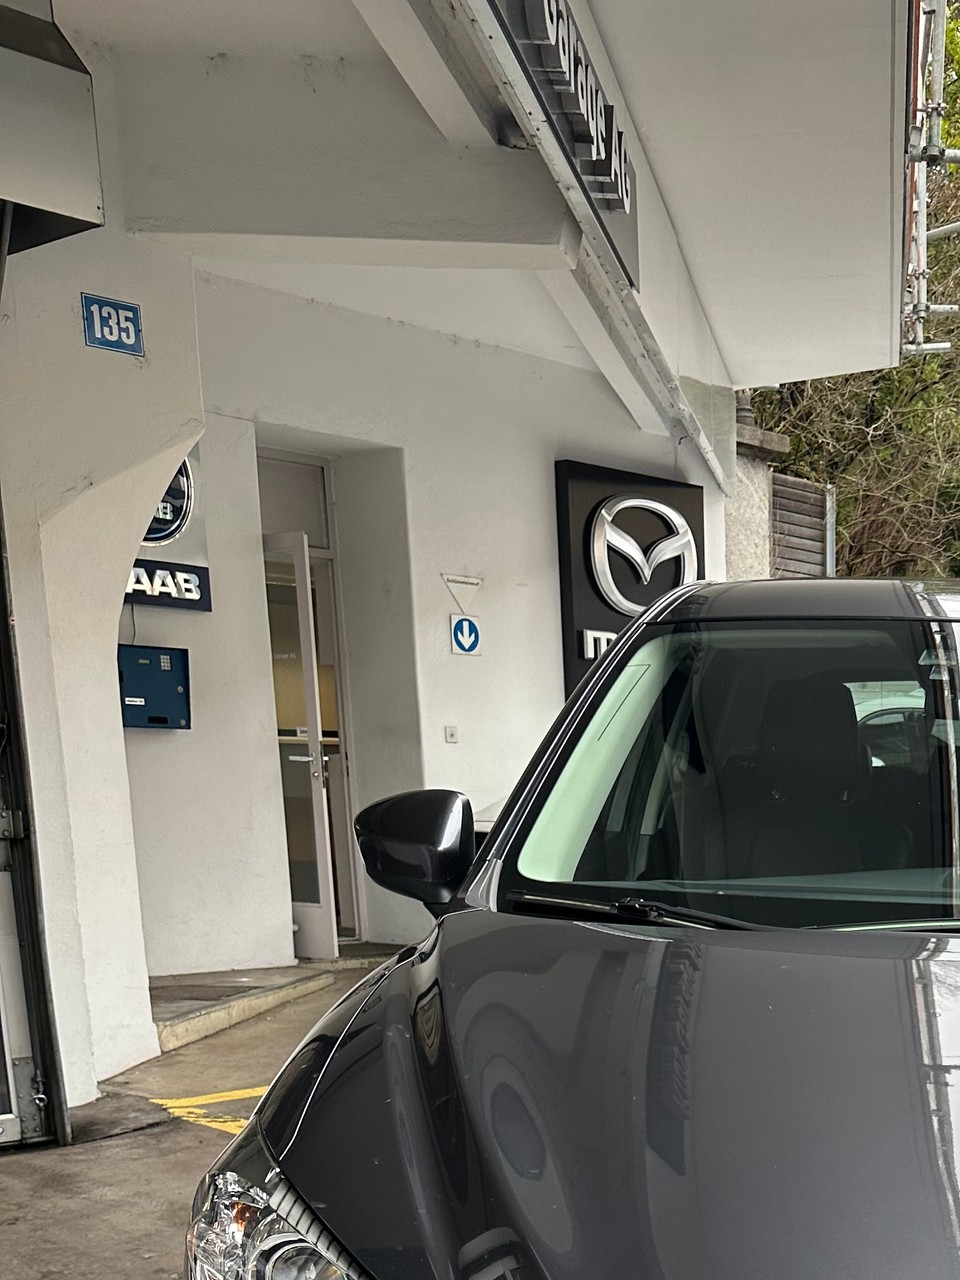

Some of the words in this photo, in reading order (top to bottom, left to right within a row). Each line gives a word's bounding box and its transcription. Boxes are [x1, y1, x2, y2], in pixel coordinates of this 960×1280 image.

[611, 105, 630, 214] AG
[90, 304, 136, 345] 135
[125, 567, 201, 600] AAB
